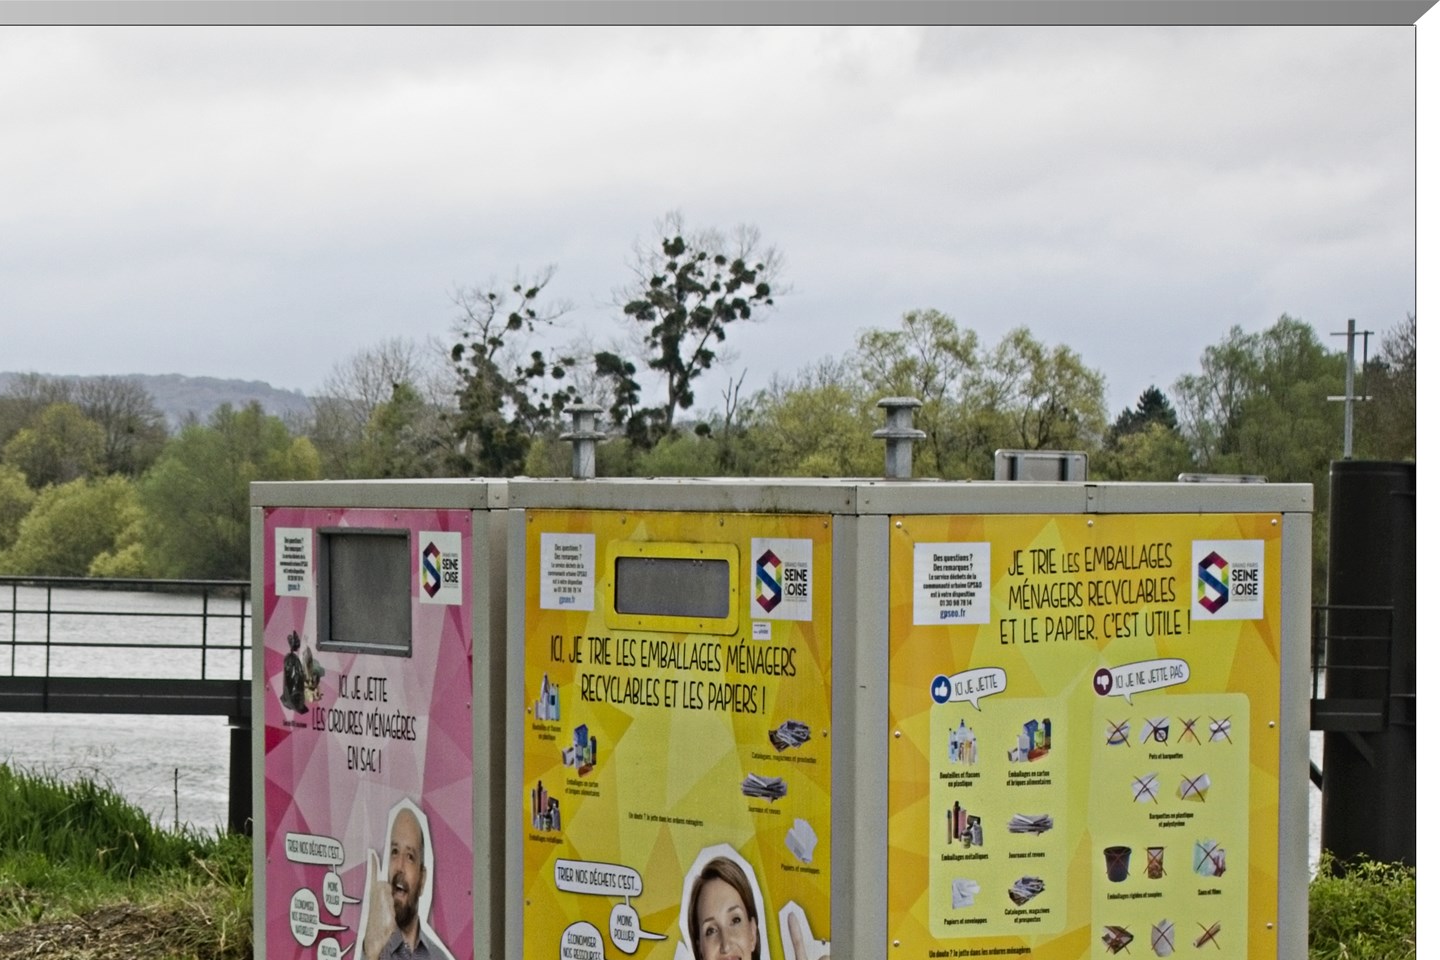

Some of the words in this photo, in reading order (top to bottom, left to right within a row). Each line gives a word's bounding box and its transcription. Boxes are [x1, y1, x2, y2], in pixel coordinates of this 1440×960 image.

[442, 558, 459, 571] SEINE
[944, 554, 969, 563] questions
[1008, 550, 1024, 576] JE
[1029, 548, 1057, 575] TRIE
[1062, 552, 1080, 574] LES
[1085, 542, 1173, 572] EMBALLAGES
[784, 569, 808, 581] SEINE
[1232, 569, 1258, 582] SEINE
[1009, 578, 1083, 611] MÉNAGERS
[1088, 576, 1176, 607] RECYCLABLES
[940, 608, 965, 619] gpseo.fr
[1000, 618, 1017, 645] ET
[1023, 617, 1040, 644] LE
[1103, 612, 1139, 639] C'EST
[1145, 609, 1182, 636] UTILE
[569, 636, 582, 664] JE
[588, 637, 611, 666] TRIE
[616, 638, 636, 666] LES
[640, 639, 722, 672] EMBALLAGES
[726, 638, 796, 676] MÉNAGERS
[955, 682, 963, 696] ICI
[965, 679, 974, 694] JE
[976, 674, 998, 692] JETTE
[1126, 673, 1134, 687] JE
[1136, 671, 1145, 685] NE
[1148, 667, 1168, 683] JETTE
[1170, 664, 1183, 679] PAS
[352, 676, 360, 700] JE
[364, 676, 387, 702] JETTE
[581, 674, 660, 707] RECYCLABLES
[664, 680, 679, 708] ET
[682, 680, 704, 710] LES
[708, 682, 758, 714] PAPIERS
[312, 707, 325, 731] LES
[328, 708, 363, 736] ORDURES
[366, 707, 416, 740] MÉNAGÈRES
[348, 745, 358, 770] EN
[360, 747, 376, 772] SAC
[557, 866, 574, 882] TRIER
[576, 869, 588, 884] NOS
[590, 868, 616, 888] DÉCHETS
[616, 914, 632, 927] MOINS
